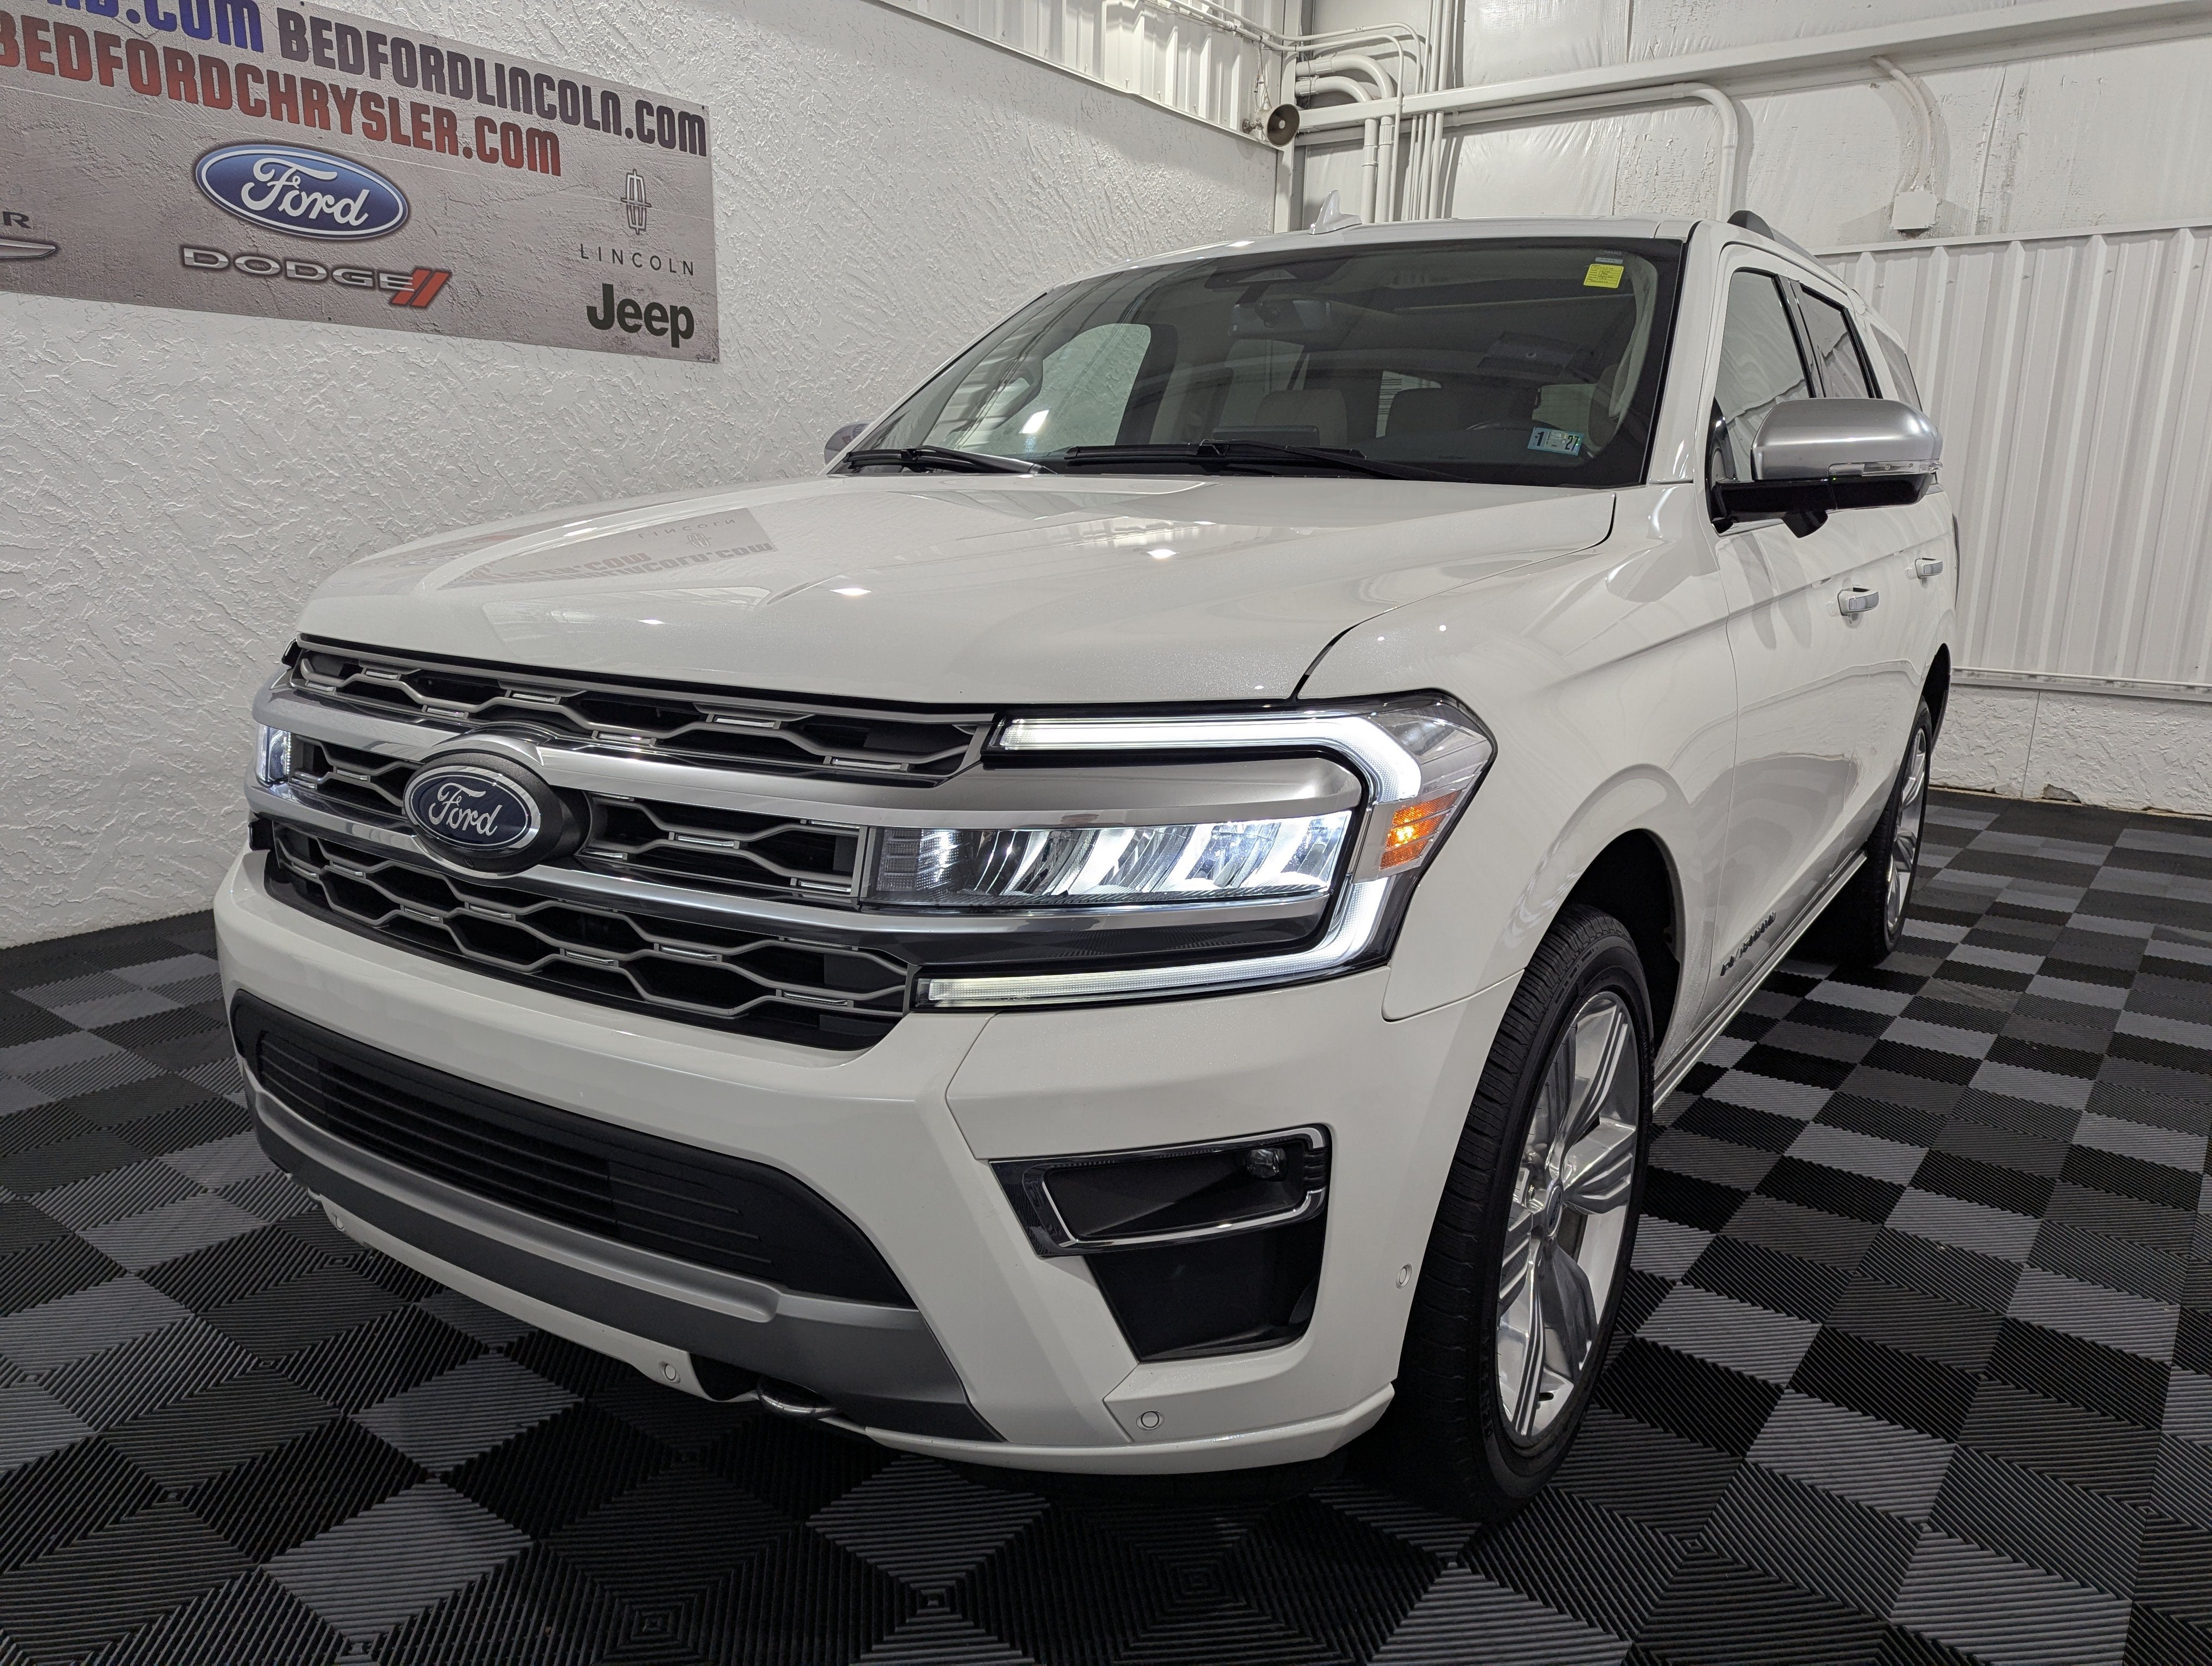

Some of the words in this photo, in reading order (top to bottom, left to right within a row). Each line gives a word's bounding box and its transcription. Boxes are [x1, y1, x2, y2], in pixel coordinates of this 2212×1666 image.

[0, 11, 561, 177] BEDFORDCHRYSLER.COM
[48, 0, 264, 53] .COM
[277, 8, 707, 157] BEDFORDLINCOLN.COM
[241, 157, 370, 226] Ford
[184, 248, 415, 291] DODGE
[580, 244, 694, 276] LINCOLN
[586, 283, 695, 348] Jeep
[1565, 435, 1579, 452] 27
[428, 783, 503, 836] Ford
